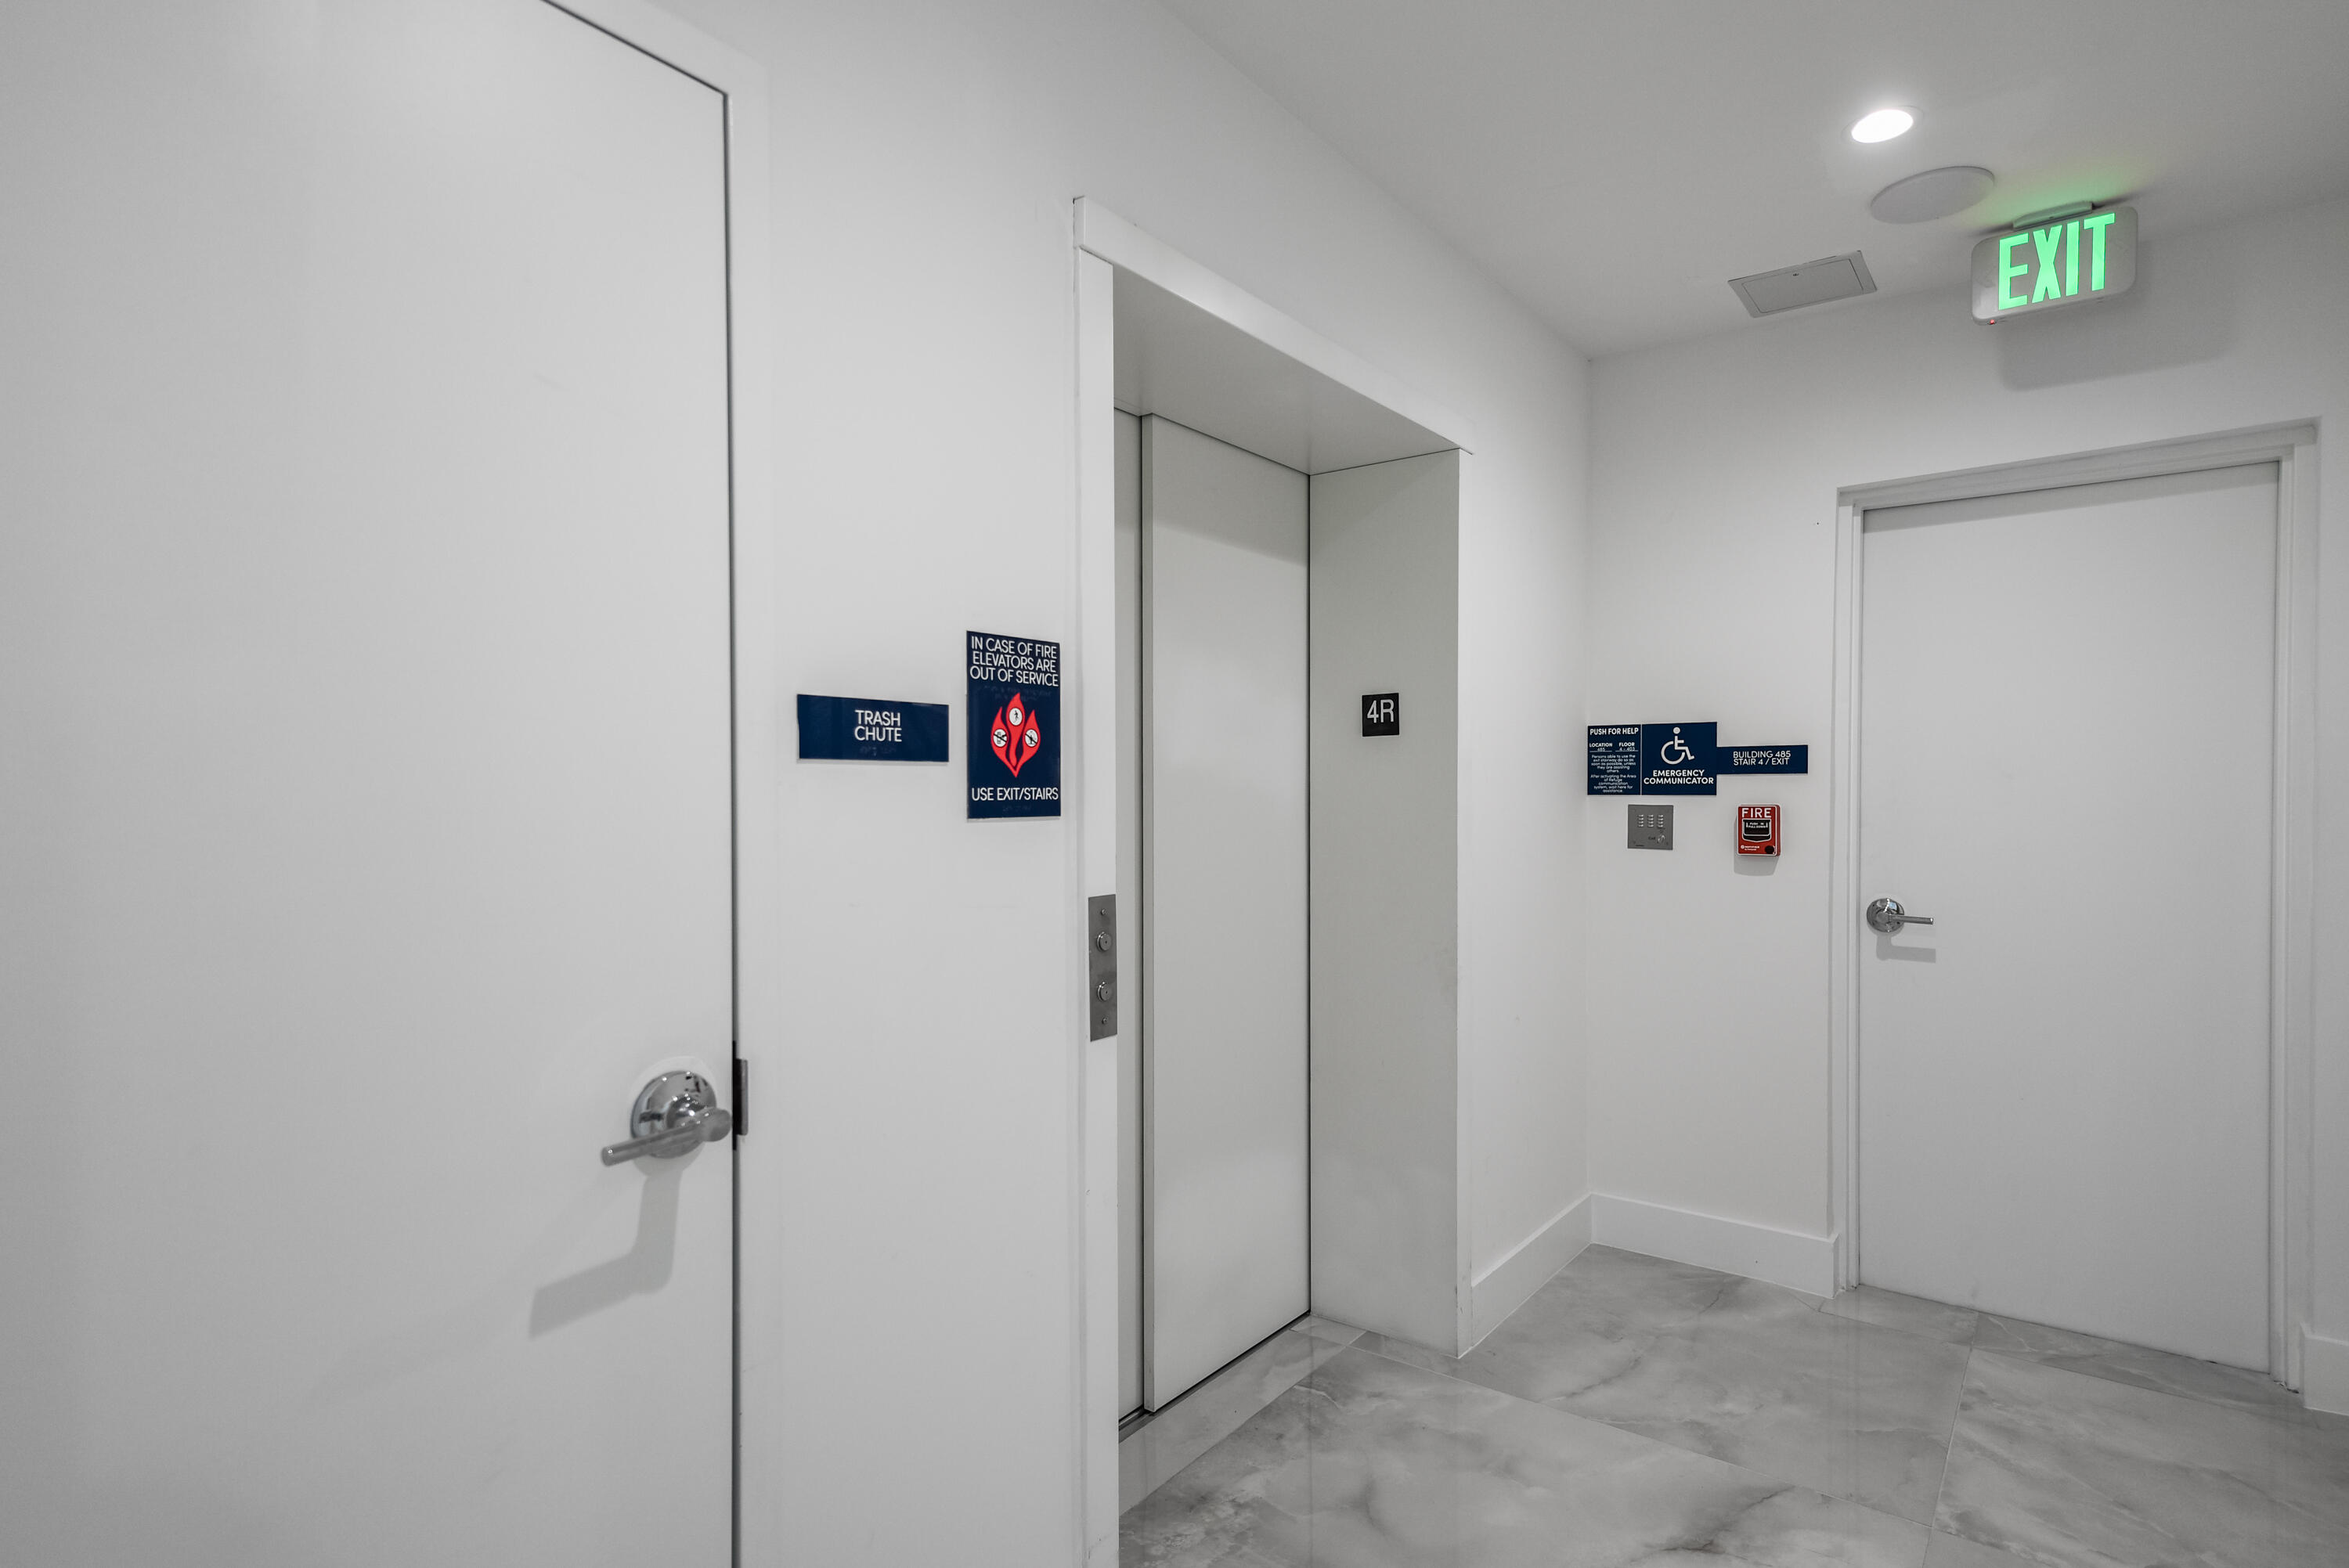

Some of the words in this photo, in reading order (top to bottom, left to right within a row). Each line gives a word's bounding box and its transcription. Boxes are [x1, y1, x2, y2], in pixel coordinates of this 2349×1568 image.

[1999, 213, 2115, 310] EXIT
[971, 636, 983, 650] IN
[986, 638, 1015, 654] CASE
[1018, 642, 1034, 655] OF
[1035, 644, 1057, 658] FIRE
[972, 651, 1034, 670] ELEVATORS
[1036, 658, 1056, 672] ARE
[970, 665, 996, 680] OUT
[998, 669, 1014, 682] OF
[1016, 670, 1059, 687] SERVICE
[854, 709, 900, 726] TRASH
[1367, 699, 1395, 723] 4R
[854, 725, 902, 742] CHUTE
[972, 787, 994, 801] USE
[997, 787, 1059, 801] EXIT/STAIRS
[1741, 807, 1772, 818] FIRE
